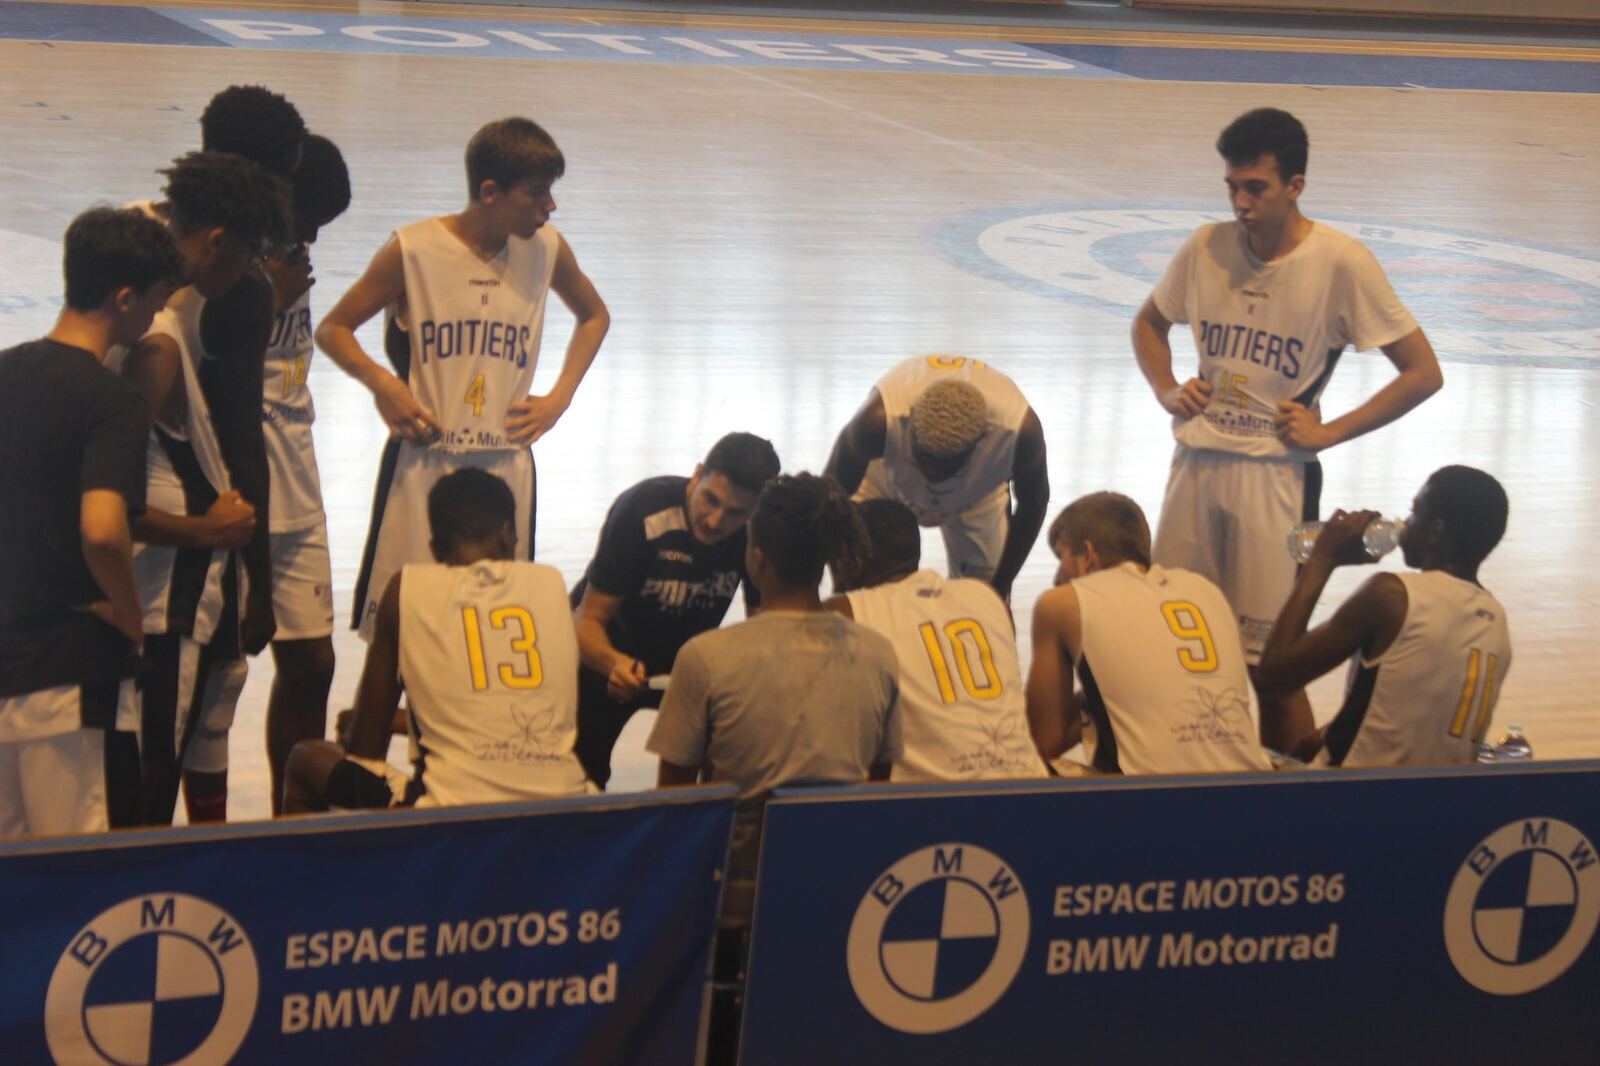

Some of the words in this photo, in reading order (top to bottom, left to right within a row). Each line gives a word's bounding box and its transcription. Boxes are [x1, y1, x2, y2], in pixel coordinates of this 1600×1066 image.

[200, 18, 1077, 71] POITIERS
[421, 319, 530, 369] POITIERS
[463, 373, 485, 417] 4
[462, 606, 544, 691] 13
[919, 618, 1004, 704] 10
[1160, 600, 1218, 673] 9
[1448, 647, 1499, 743] 11
[1053, 881, 1177, 918] ESPACE
[1182, 875, 1300, 911] MOTOS
[1305, 873, 1346, 904] 86
[284, 924, 428, 970] ESPACE
[435, 910, 569, 957] MOTOS
[577, 907, 622, 944] 86
[1046, 935, 1151, 975] BMW
[1157, 923, 1339, 969] Motorrad
[280, 985, 401, 1034] BMW
[409, 962, 618, 1020] Motorrad
